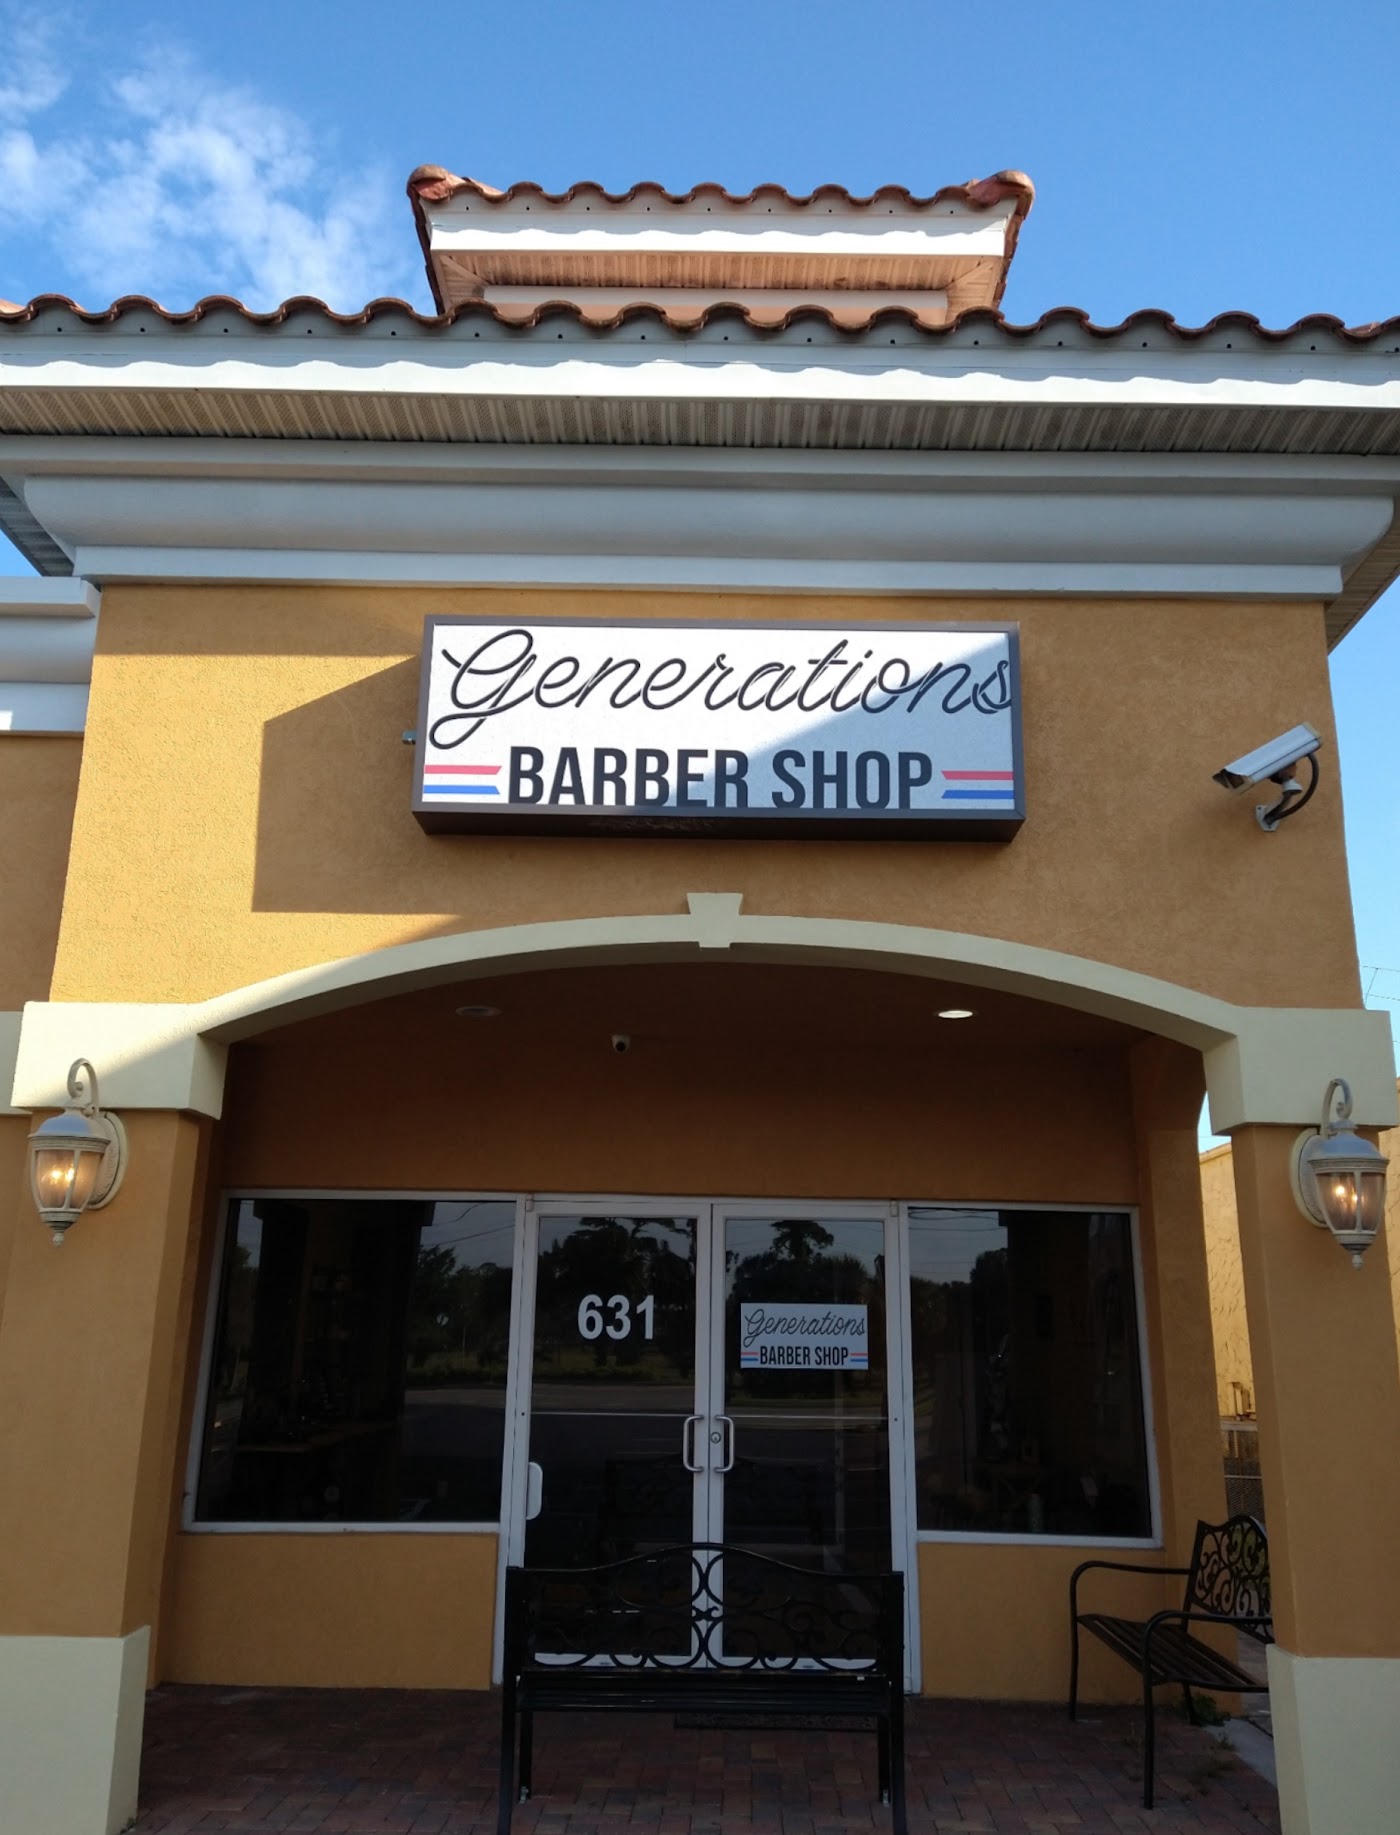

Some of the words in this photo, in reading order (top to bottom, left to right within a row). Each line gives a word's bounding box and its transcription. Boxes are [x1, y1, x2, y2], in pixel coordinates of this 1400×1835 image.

[429, 628, 1012, 750] Generations
[508, 746, 749, 808] BARBER
[771, 749, 933, 810] SHOP
[577, 1293, 656, 1341] 631
[743, 1308, 865, 1348] Generations
[759, 1345, 811, 1366] BARBER
[814, 1347, 849, 1366] SHOP
